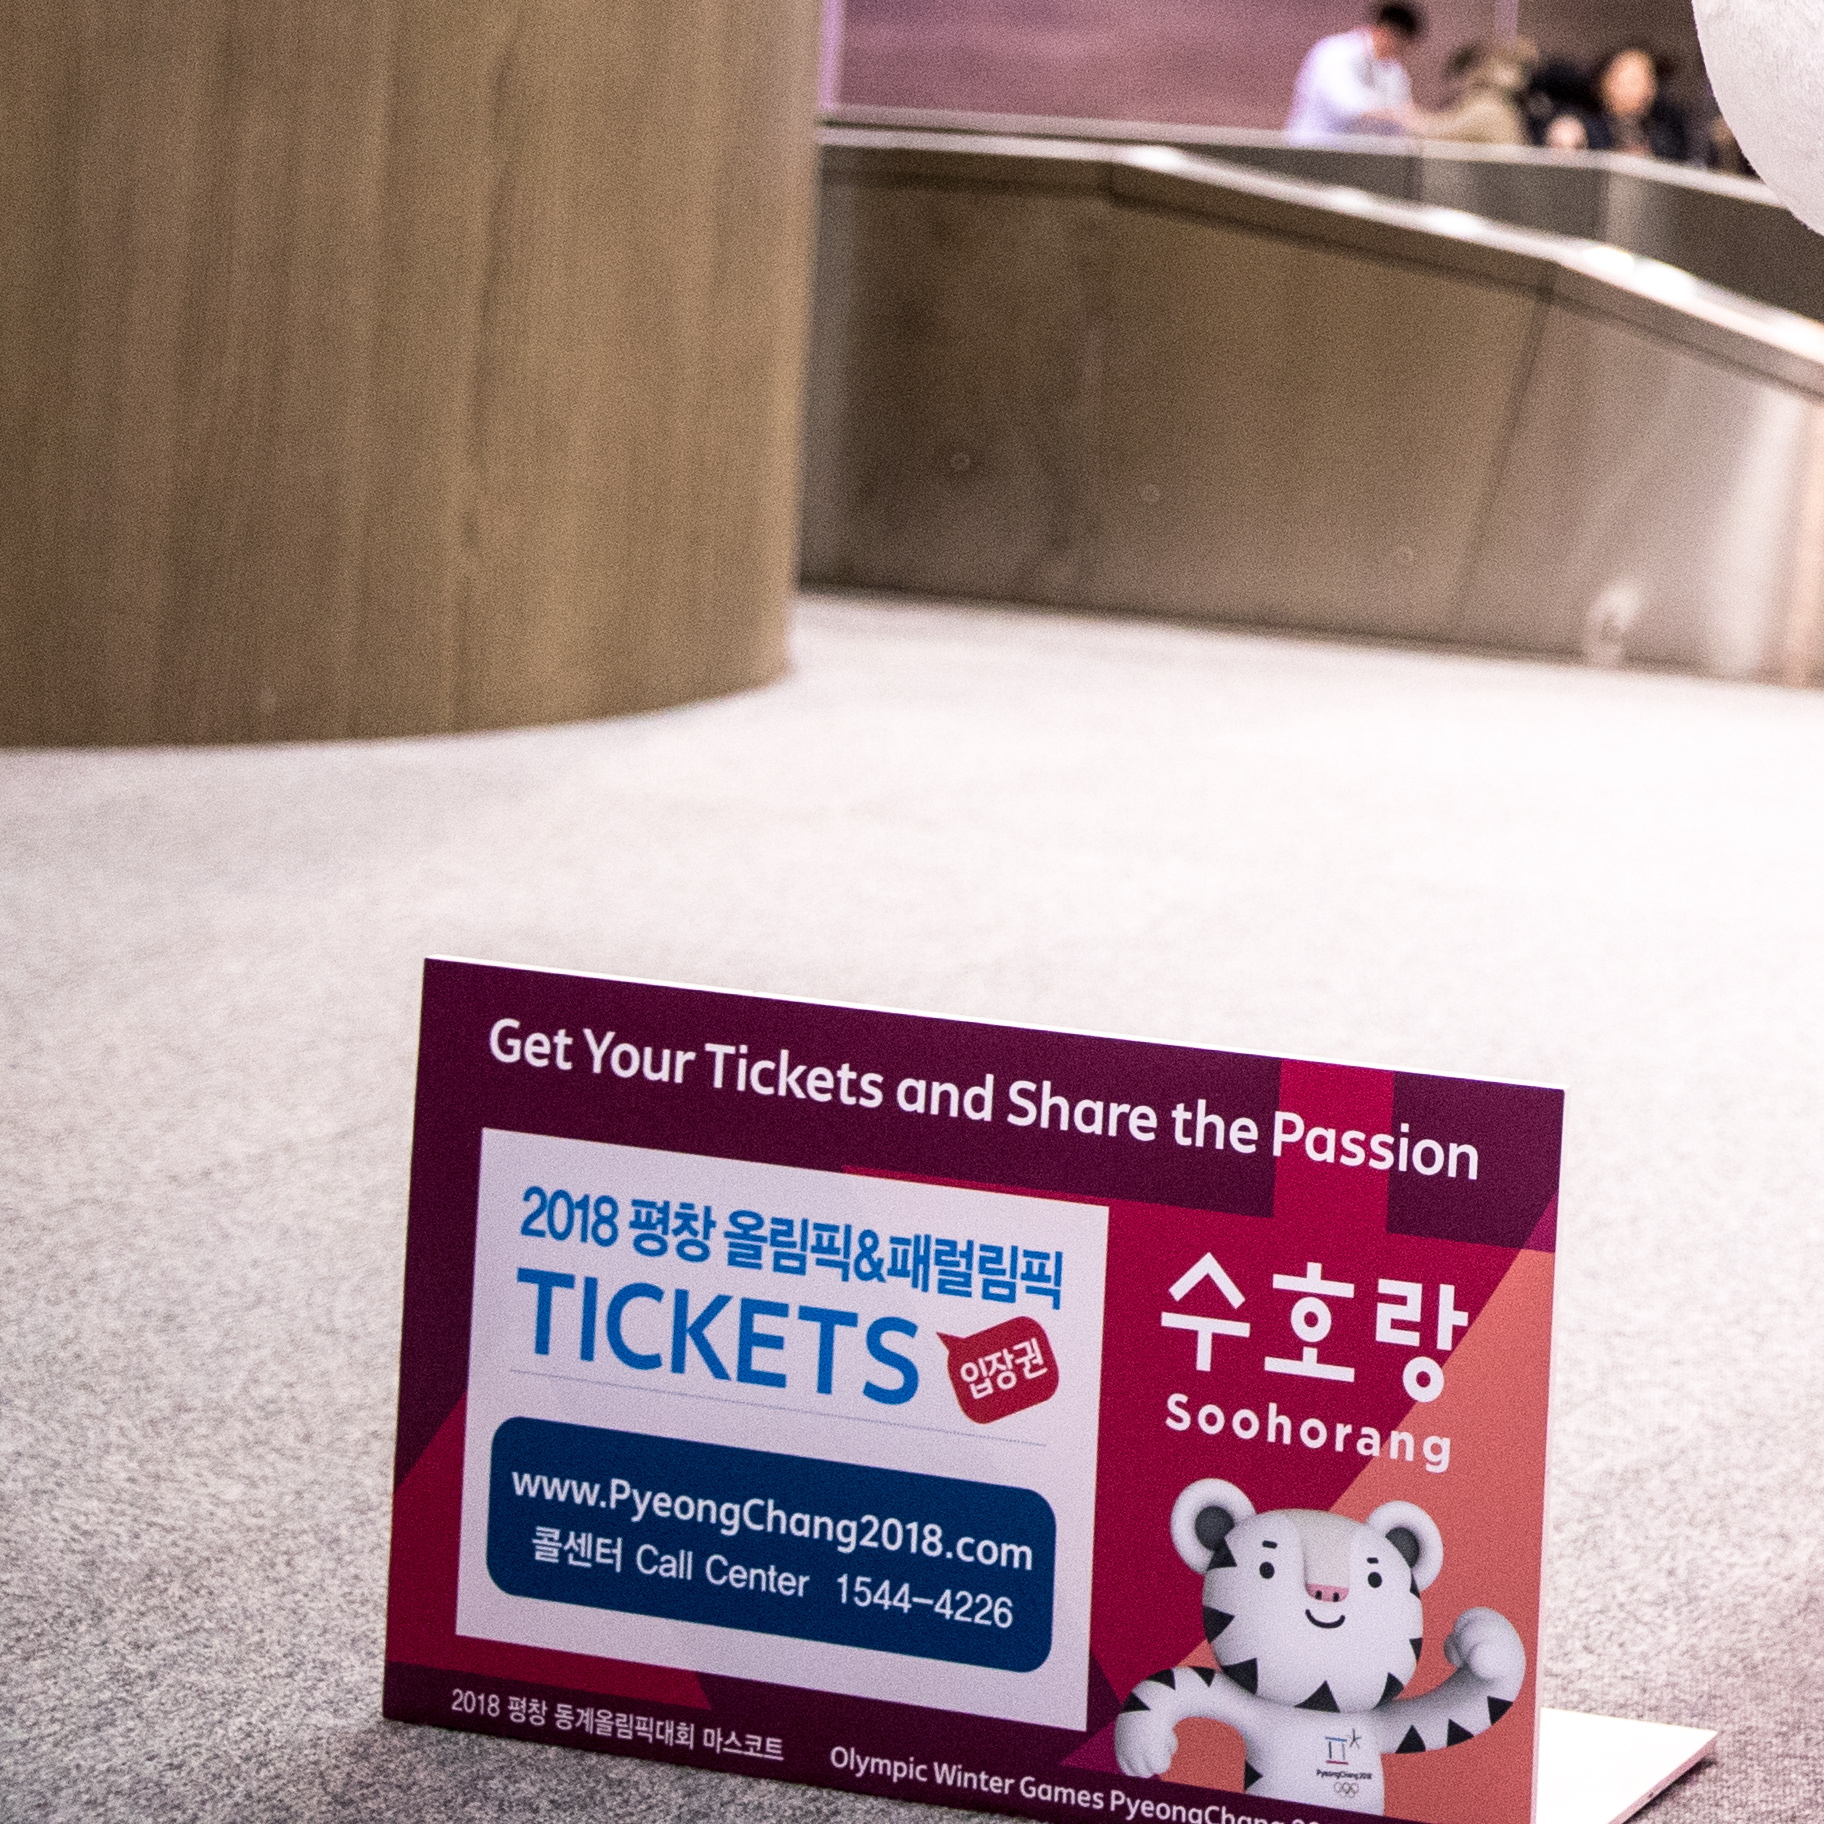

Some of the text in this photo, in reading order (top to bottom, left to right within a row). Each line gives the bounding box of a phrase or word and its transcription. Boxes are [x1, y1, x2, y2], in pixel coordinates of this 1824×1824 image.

[489, 1018, 1479, 1180] Get Your Tickets and Share the Passion
[520, 1185, 1063, 1310] 2018 평창 올림픽&패럴림픽
[517, 1268, 920, 1405] TICKETS
[960, 1337, 1049, 1400] 입장권
[1160, 1252, 1469, 1402] 수호랑
[1165, 1392, 1451, 1473] Soohorang
[511, 1470, 1034, 1571] www.PyeongChang2018.com
[531, 1526, 1014, 1629] 콜센터 Call Center 1544-4226
[450, 1688, 785, 1761] 2018 평창 동계올림픽대회 마스코트
[829, 1745, 928, 1783] Olympic
[932, 1759, 1016, 1796] Winter
[1019, 1775, 1104, 1811] Games
